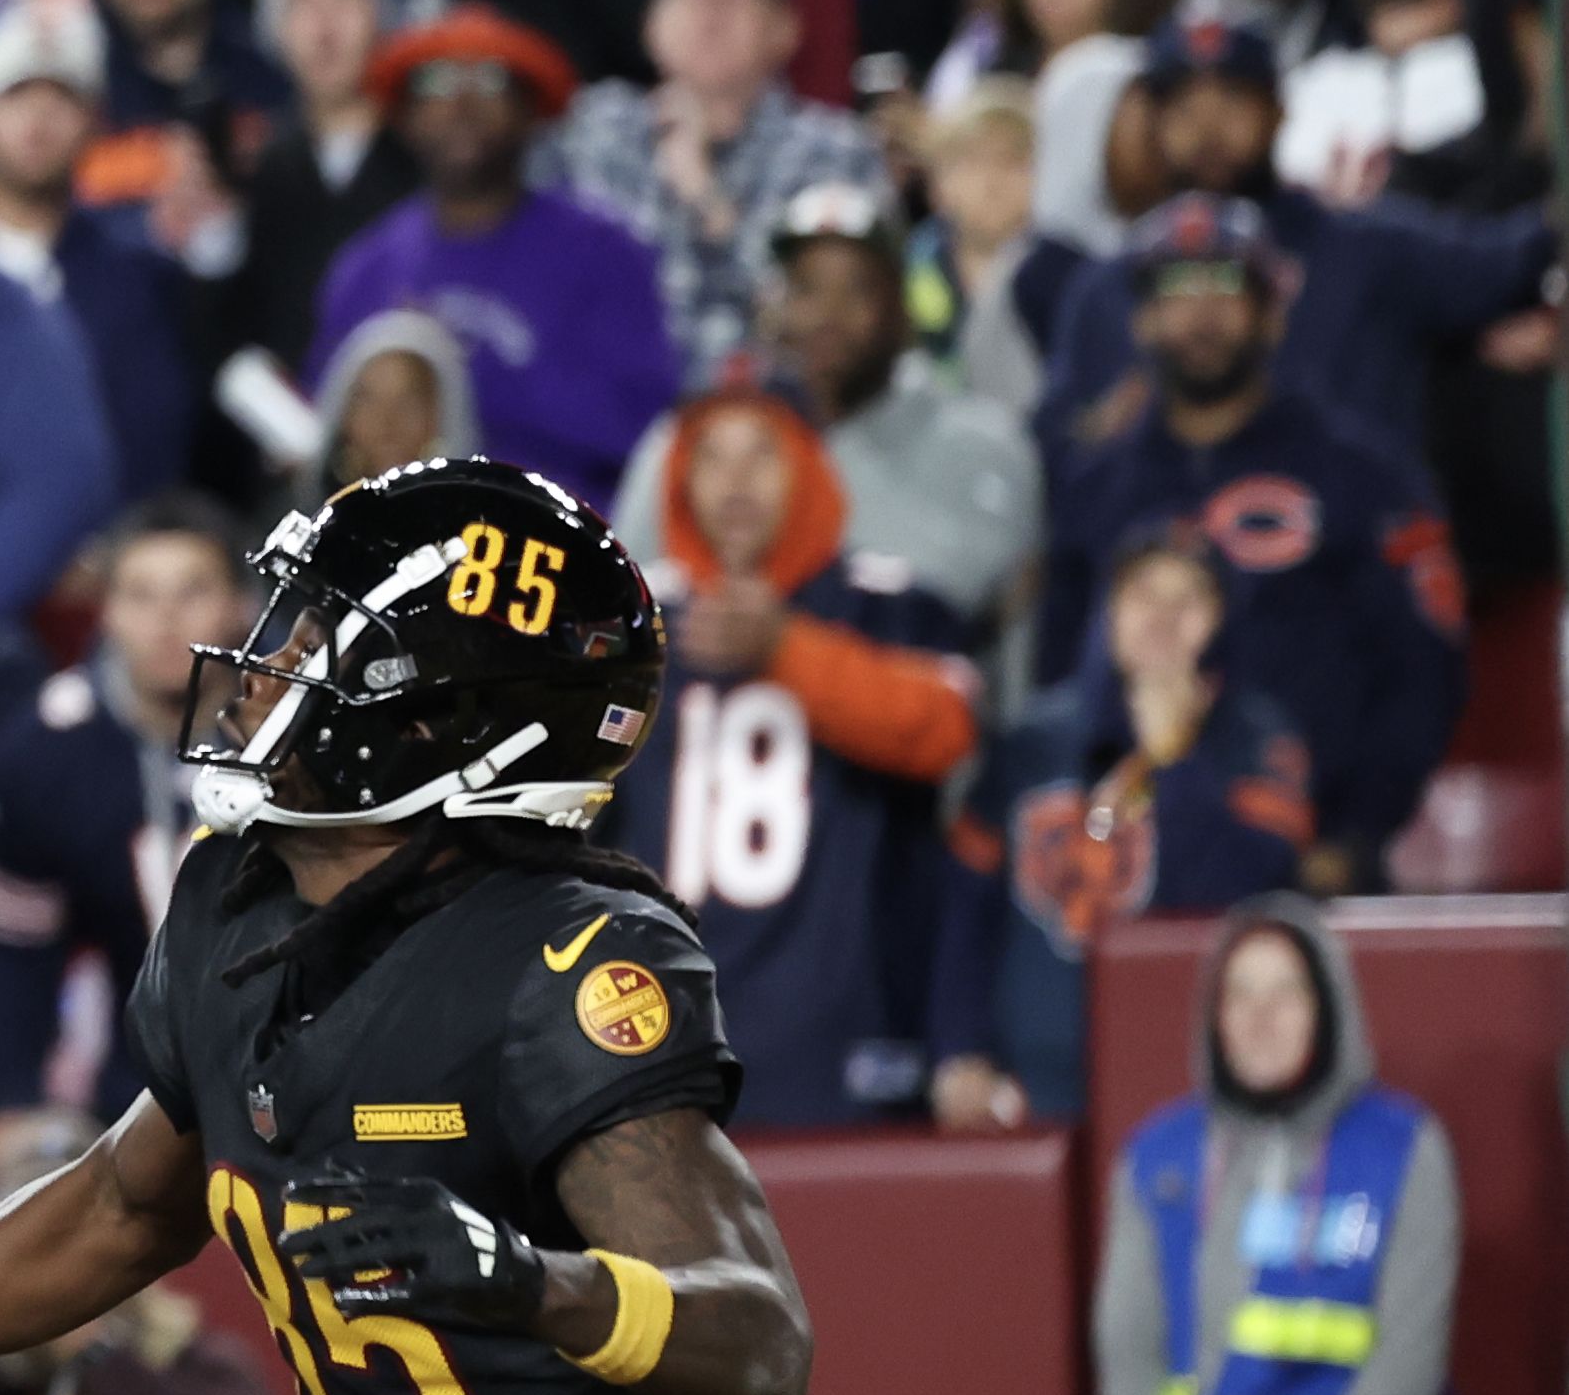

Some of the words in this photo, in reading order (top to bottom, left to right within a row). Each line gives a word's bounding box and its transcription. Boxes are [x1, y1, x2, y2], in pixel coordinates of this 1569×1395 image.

[447, 520, 565, 636] 85
[664, 679, 813, 909] 18
[353, 1110, 466, 1135] COMMANDERS
